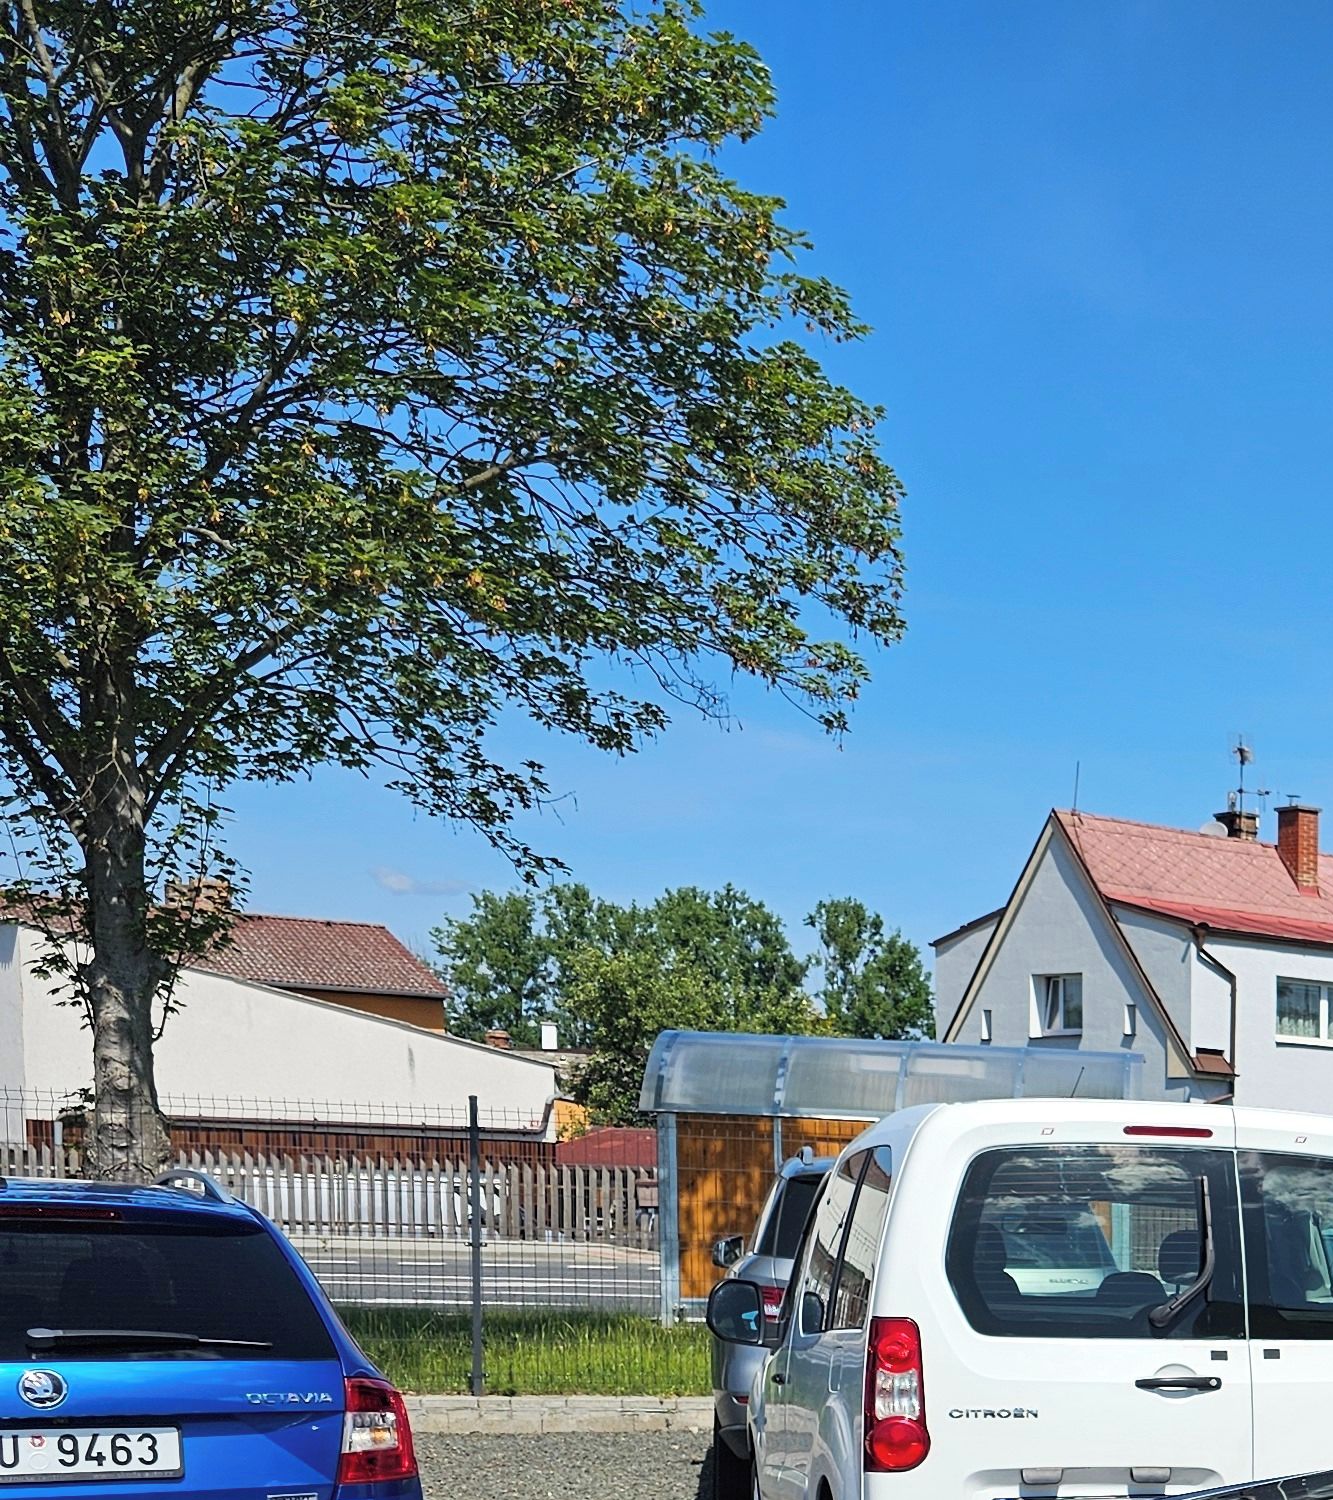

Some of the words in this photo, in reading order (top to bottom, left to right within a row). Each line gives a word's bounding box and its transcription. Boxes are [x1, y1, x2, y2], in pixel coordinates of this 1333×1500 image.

[246, 1392, 333, 1404] OCTAVIA
[948, 1407, 1039, 1419] CITROËN
[57, 1432, 160, 1468] 9463
